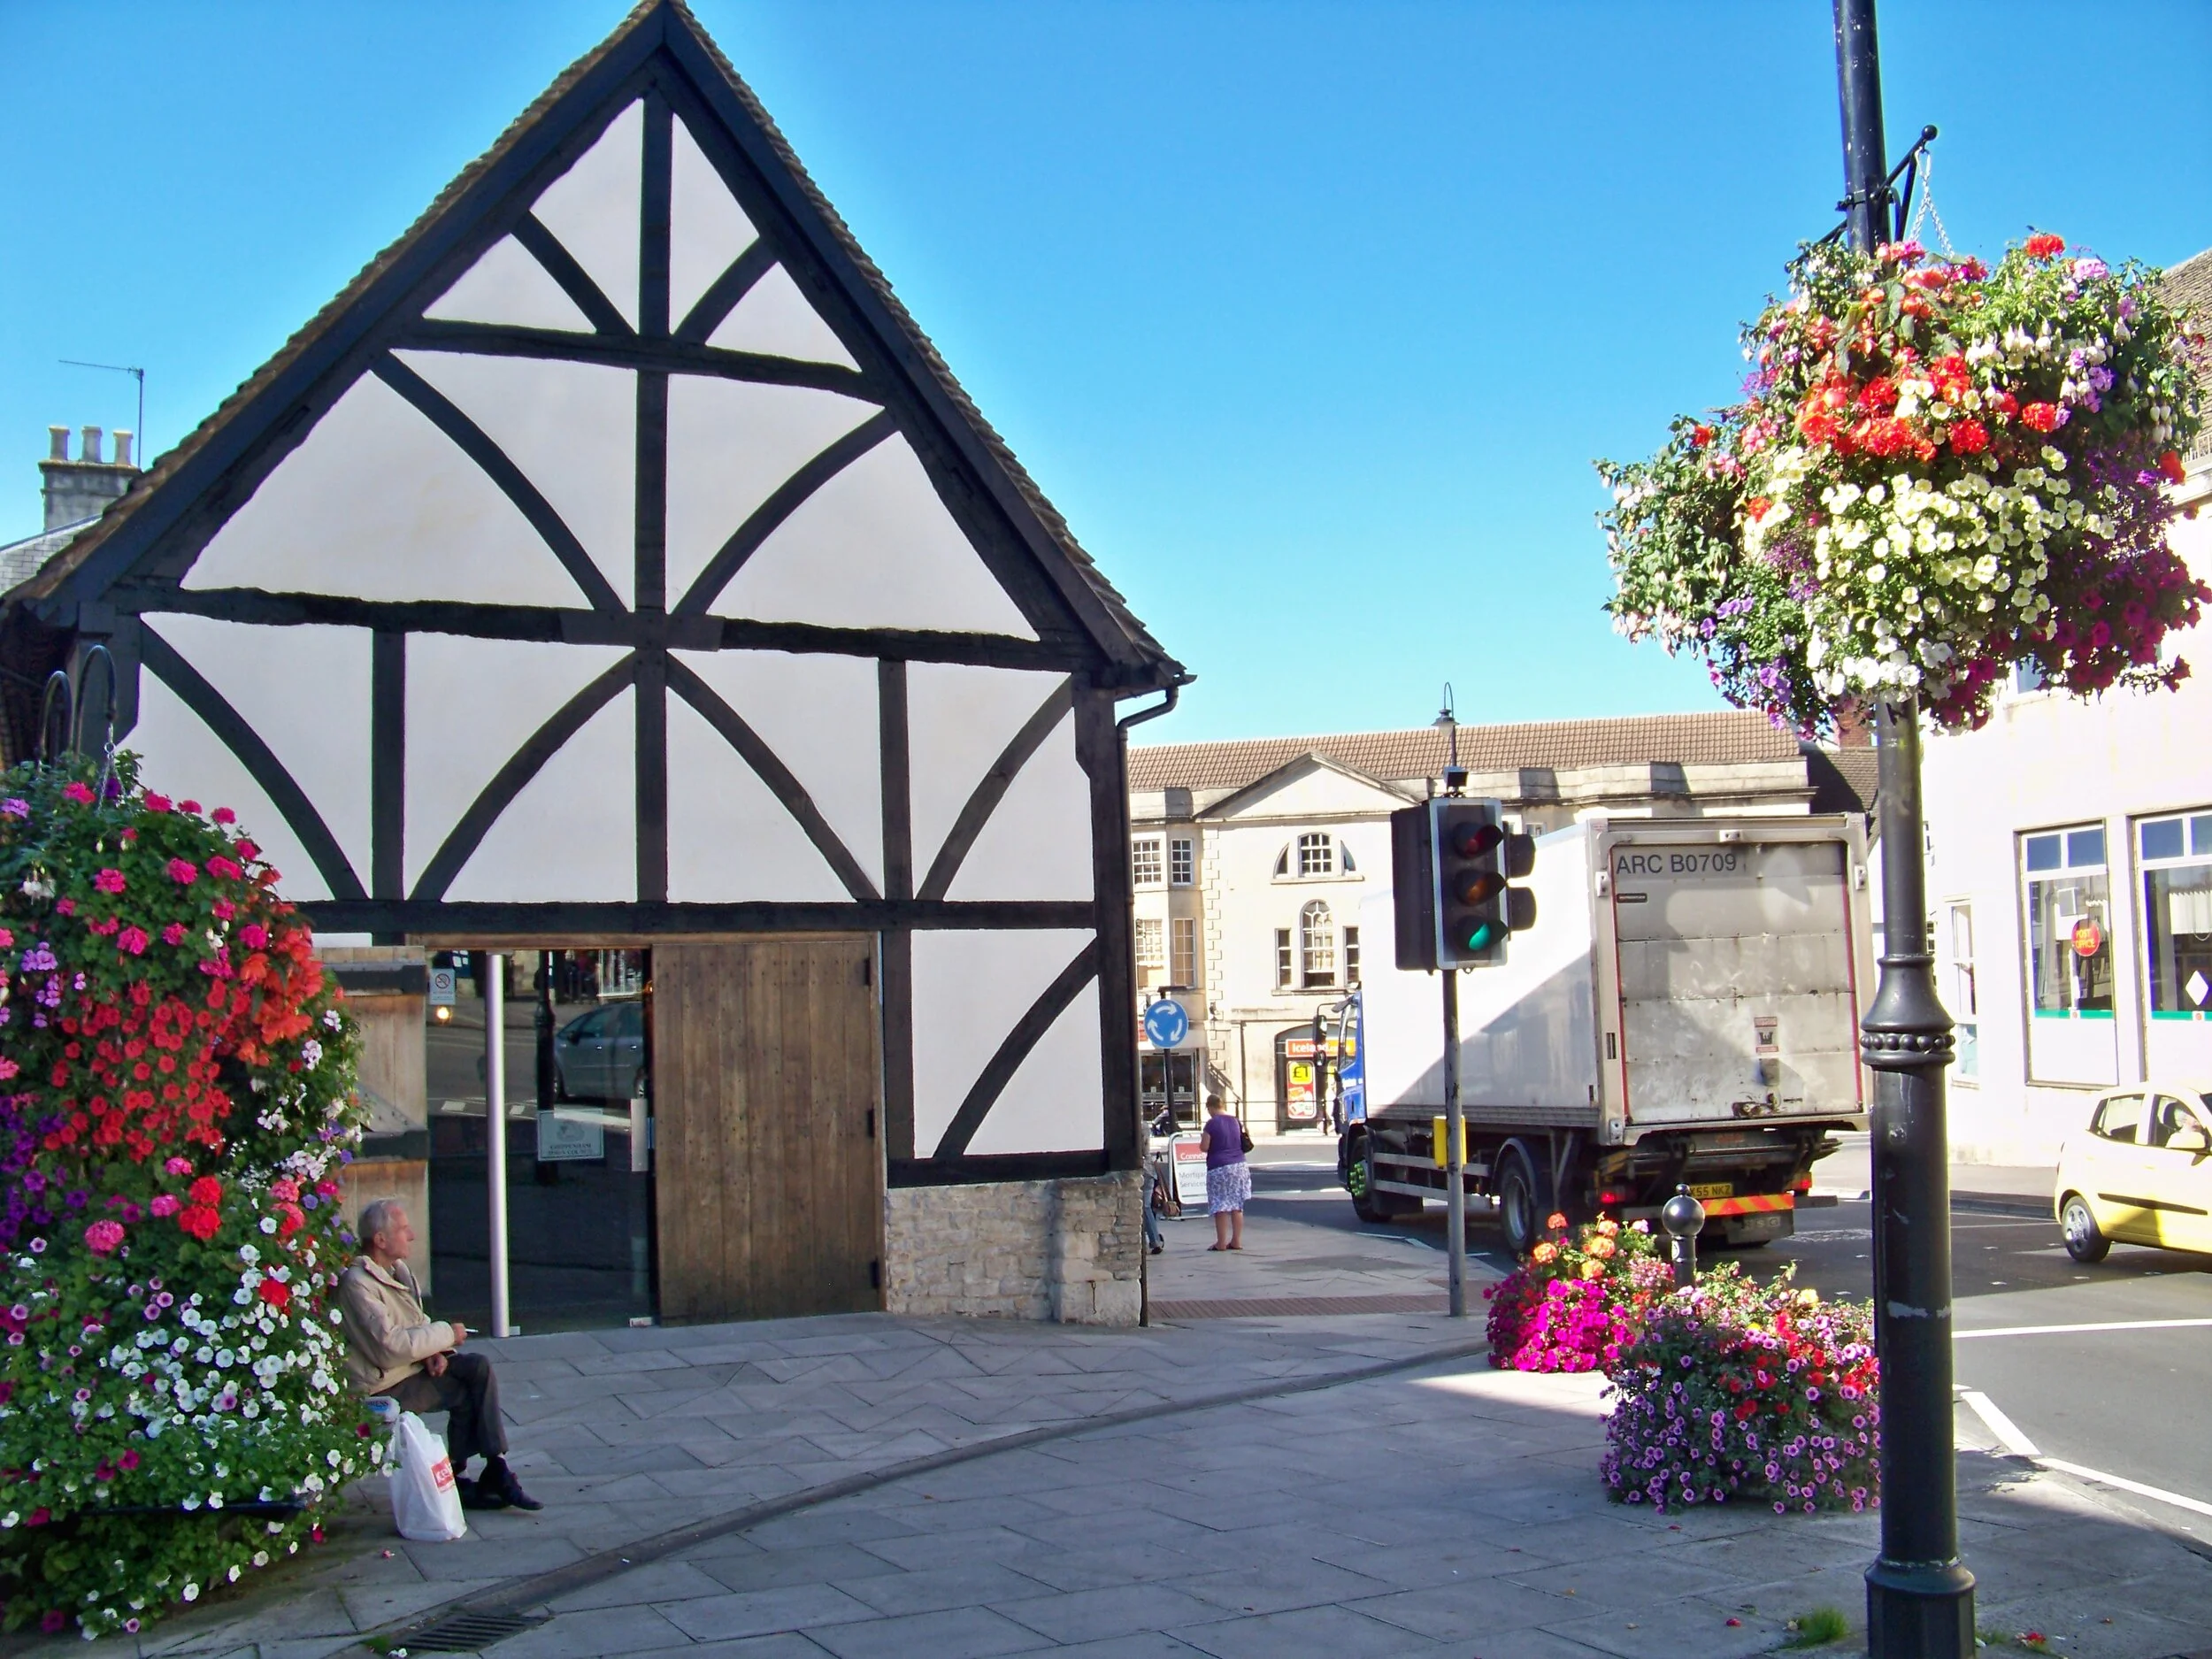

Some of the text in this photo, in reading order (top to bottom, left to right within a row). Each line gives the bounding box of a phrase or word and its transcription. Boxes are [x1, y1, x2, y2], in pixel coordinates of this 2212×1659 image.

[1616, 853, 1737, 874] ARC B0709
[2076, 929, 2092, 938] POST
[1293, 1065, 1309, 1078] £1
[1689, 1187, 1709, 1197] X55
